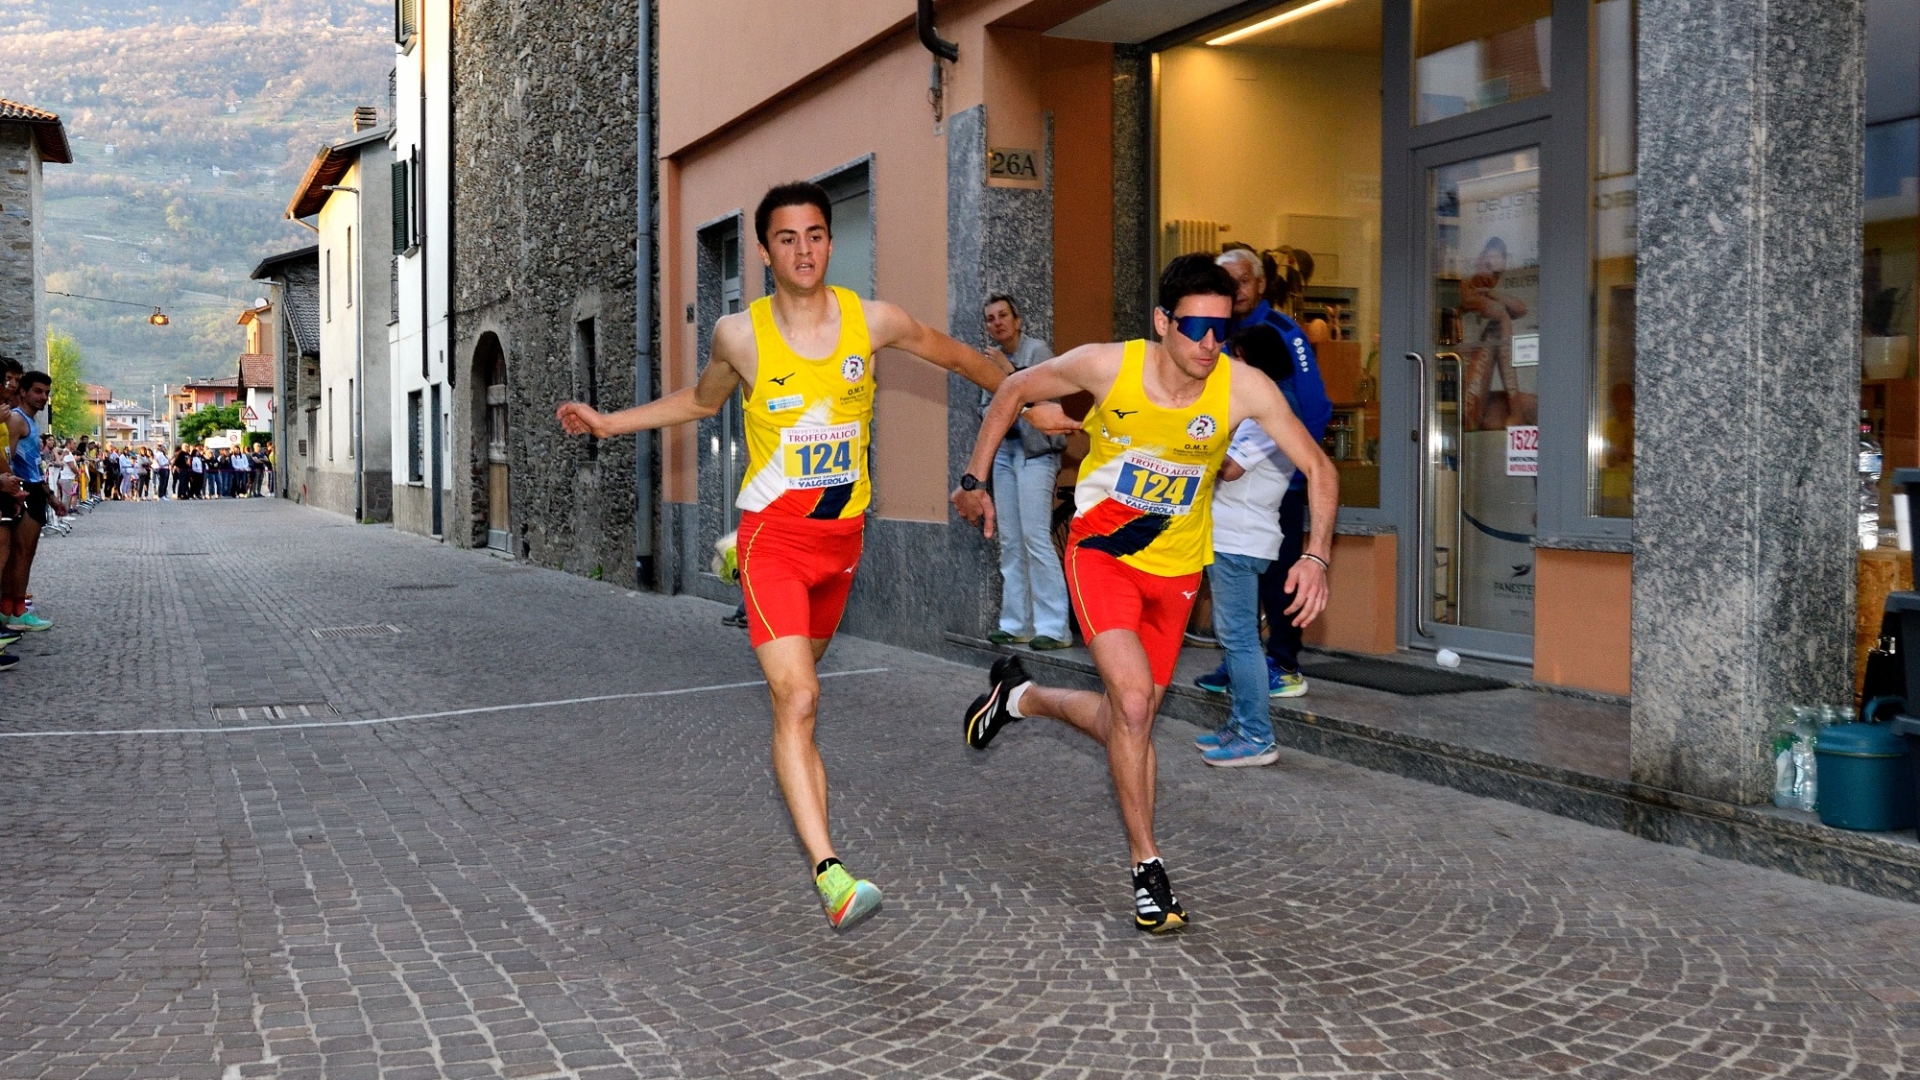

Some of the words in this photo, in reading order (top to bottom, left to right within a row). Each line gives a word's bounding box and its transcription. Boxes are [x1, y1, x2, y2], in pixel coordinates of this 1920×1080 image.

[991, 152, 1037, 177] 26A
[788, 432, 828, 443] TROFEO
[829, 429, 856, 440] ALICO
[1510, 430, 1539, 450] 1522
[796, 441, 851, 475] 124
[1131, 456, 1169, 473] TROFEO
[1170, 468, 1199, 476] ALICO
[798, 477, 849, 488] VALGEROLA
[1132, 469, 1188, 505] 124
[1125, 499, 1175, 515] VALGEROLA
